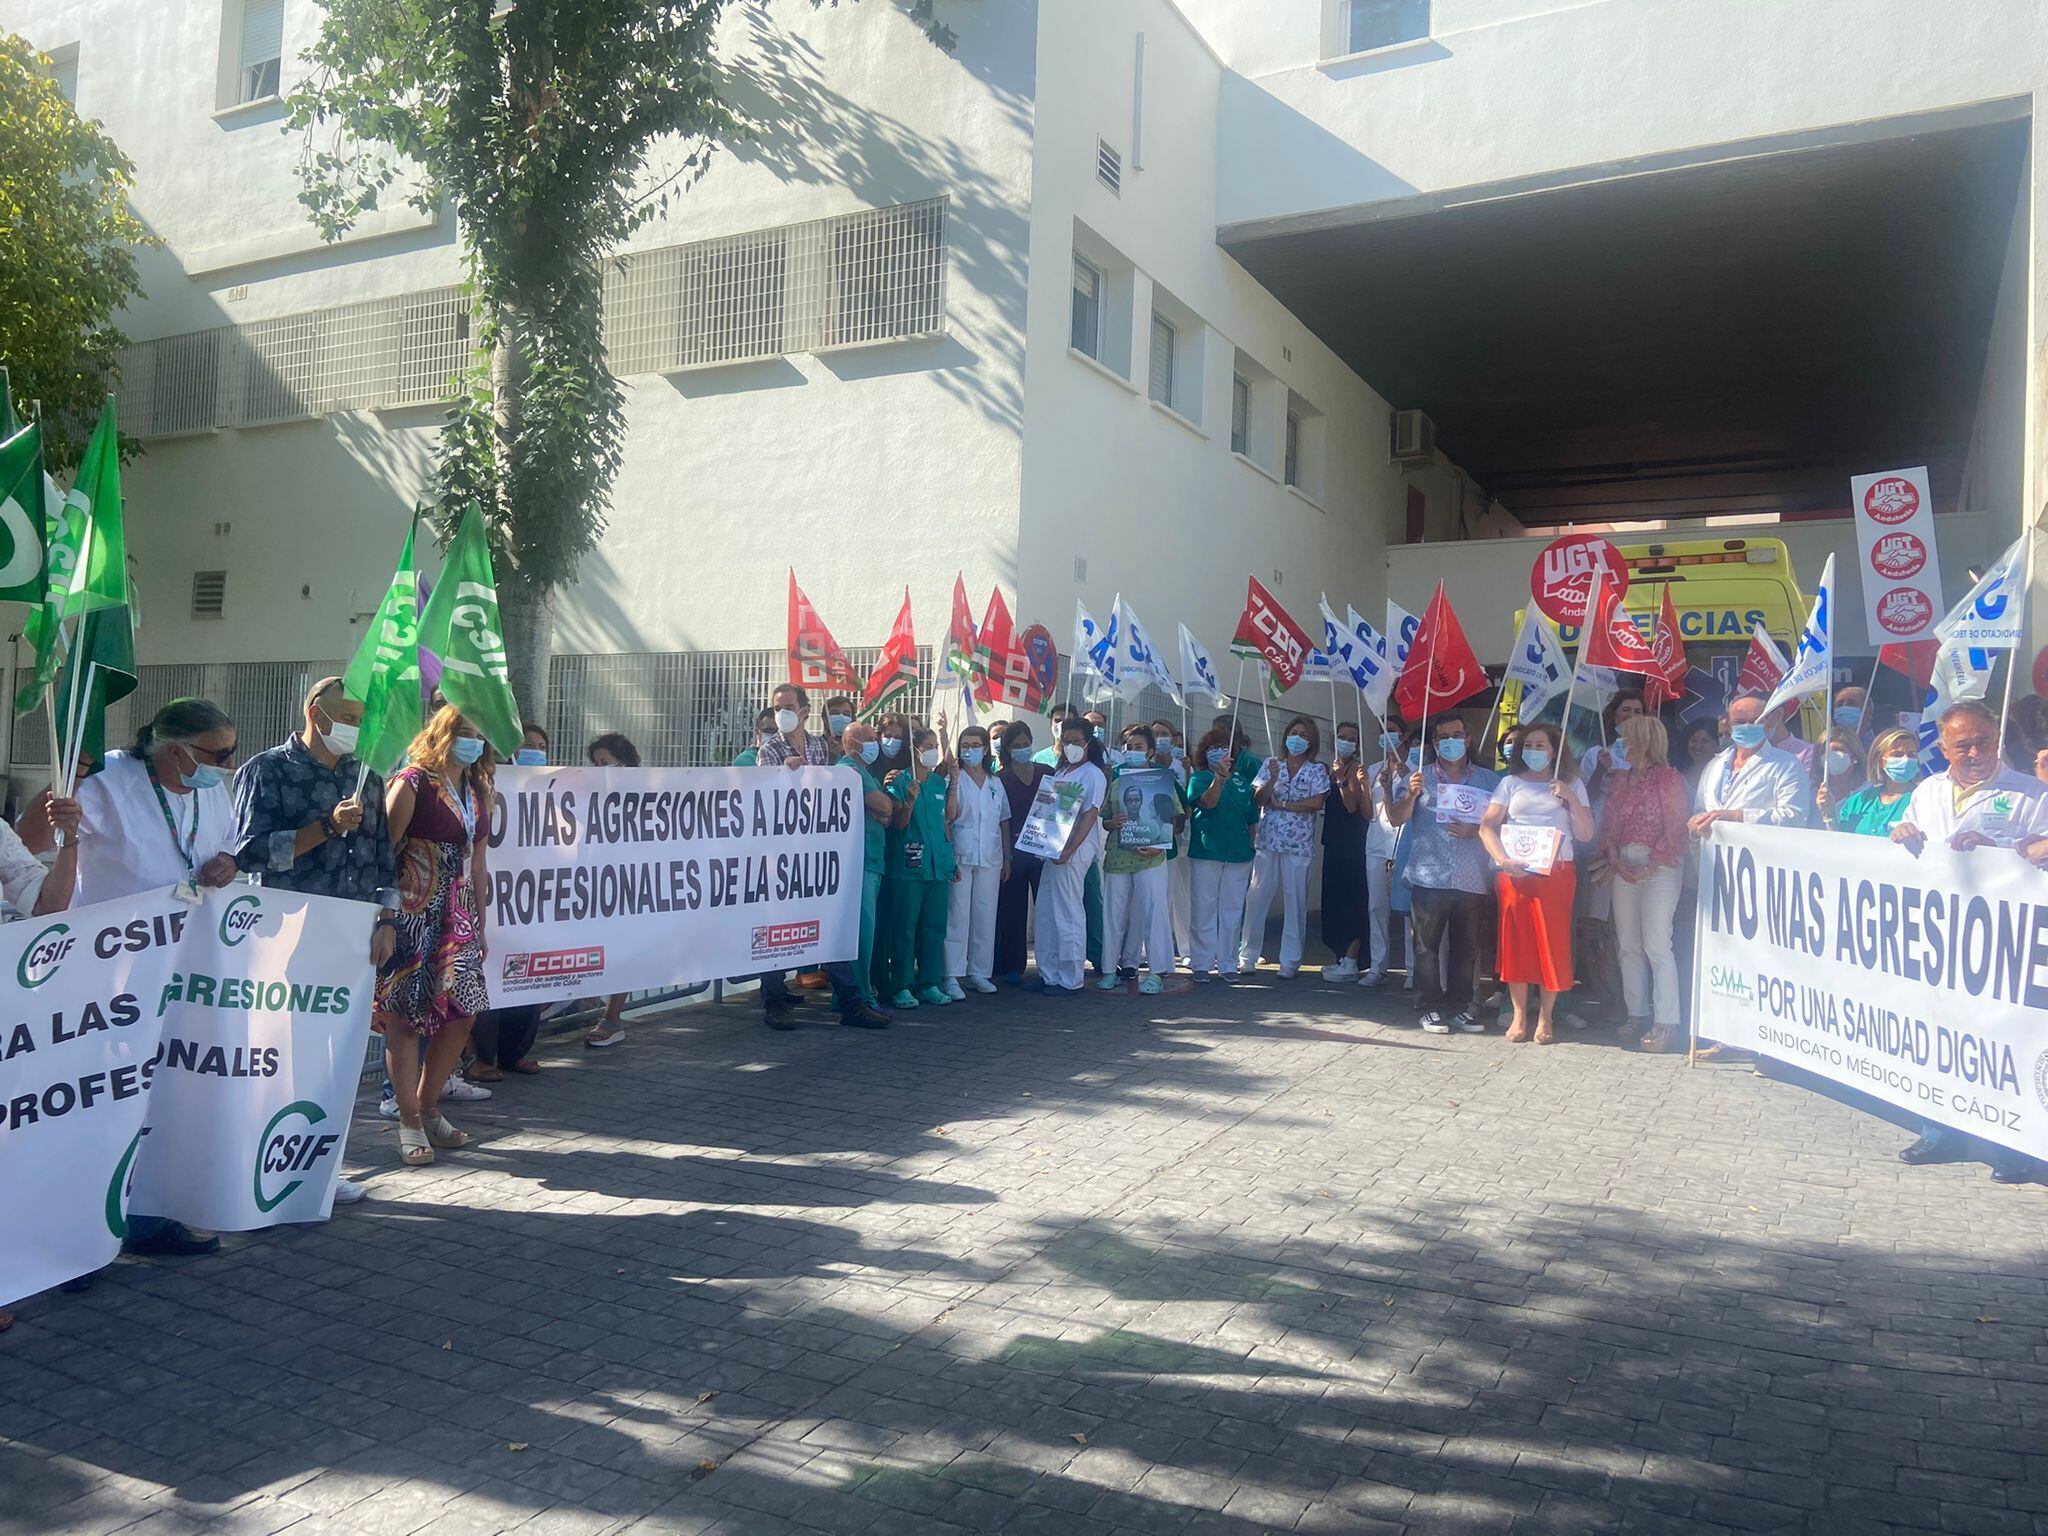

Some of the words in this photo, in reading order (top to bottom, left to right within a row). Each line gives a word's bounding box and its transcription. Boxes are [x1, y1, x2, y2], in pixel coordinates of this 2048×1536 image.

[1874, 481, 1906, 495] UGT
[1544, 540, 1612, 584] UGT
[1881, 536, 1913, 550] UGT
[1887, 591, 1919, 606] UGT
[1559, 610, 1767, 642] UECIAS
[487, 791, 508, 849] O
[517, 779, 577, 848] MÁS
[585, 789, 745, 844] AGRESIONES
[752, 789, 767, 837] A
[773, 787, 851, 835] LOS/LAS
[709, 857, 739, 908] DE
[743, 855, 769, 904] LA
[775, 850, 840, 901] SALUD
[94, 911, 188, 959] CSIF
[228, 909, 264, 931] CSIF
[771, 926, 808, 942] CCOO
[1711, 844, 1759, 940] NO
[1765, 866, 1826, 958] MAS
[1836, 876, 2048, 1011] AGRESIONE
[29, 937, 77, 968] CSIF
[533, 953, 588, 972] CCOO
[0, 1023, 36, 1061] A
[52, 993, 141, 1044] LAS
[1757, 973, 1797, 1023] POR
[1800, 985, 1841, 1038] UNA
[1843, 997, 1930, 1067] SANIDAD
[1937, 1025, 2022, 1097] DIGNA
[1758, 1025, 1843, 1066] SINDICATO
[1846, 1056, 1913, 1094] MÉDICO
[1918, 1081, 1945, 1107] DE
[1951, 1094, 2023, 1132] CÁDIZ
[263, 1134, 339, 1173] CSIF
